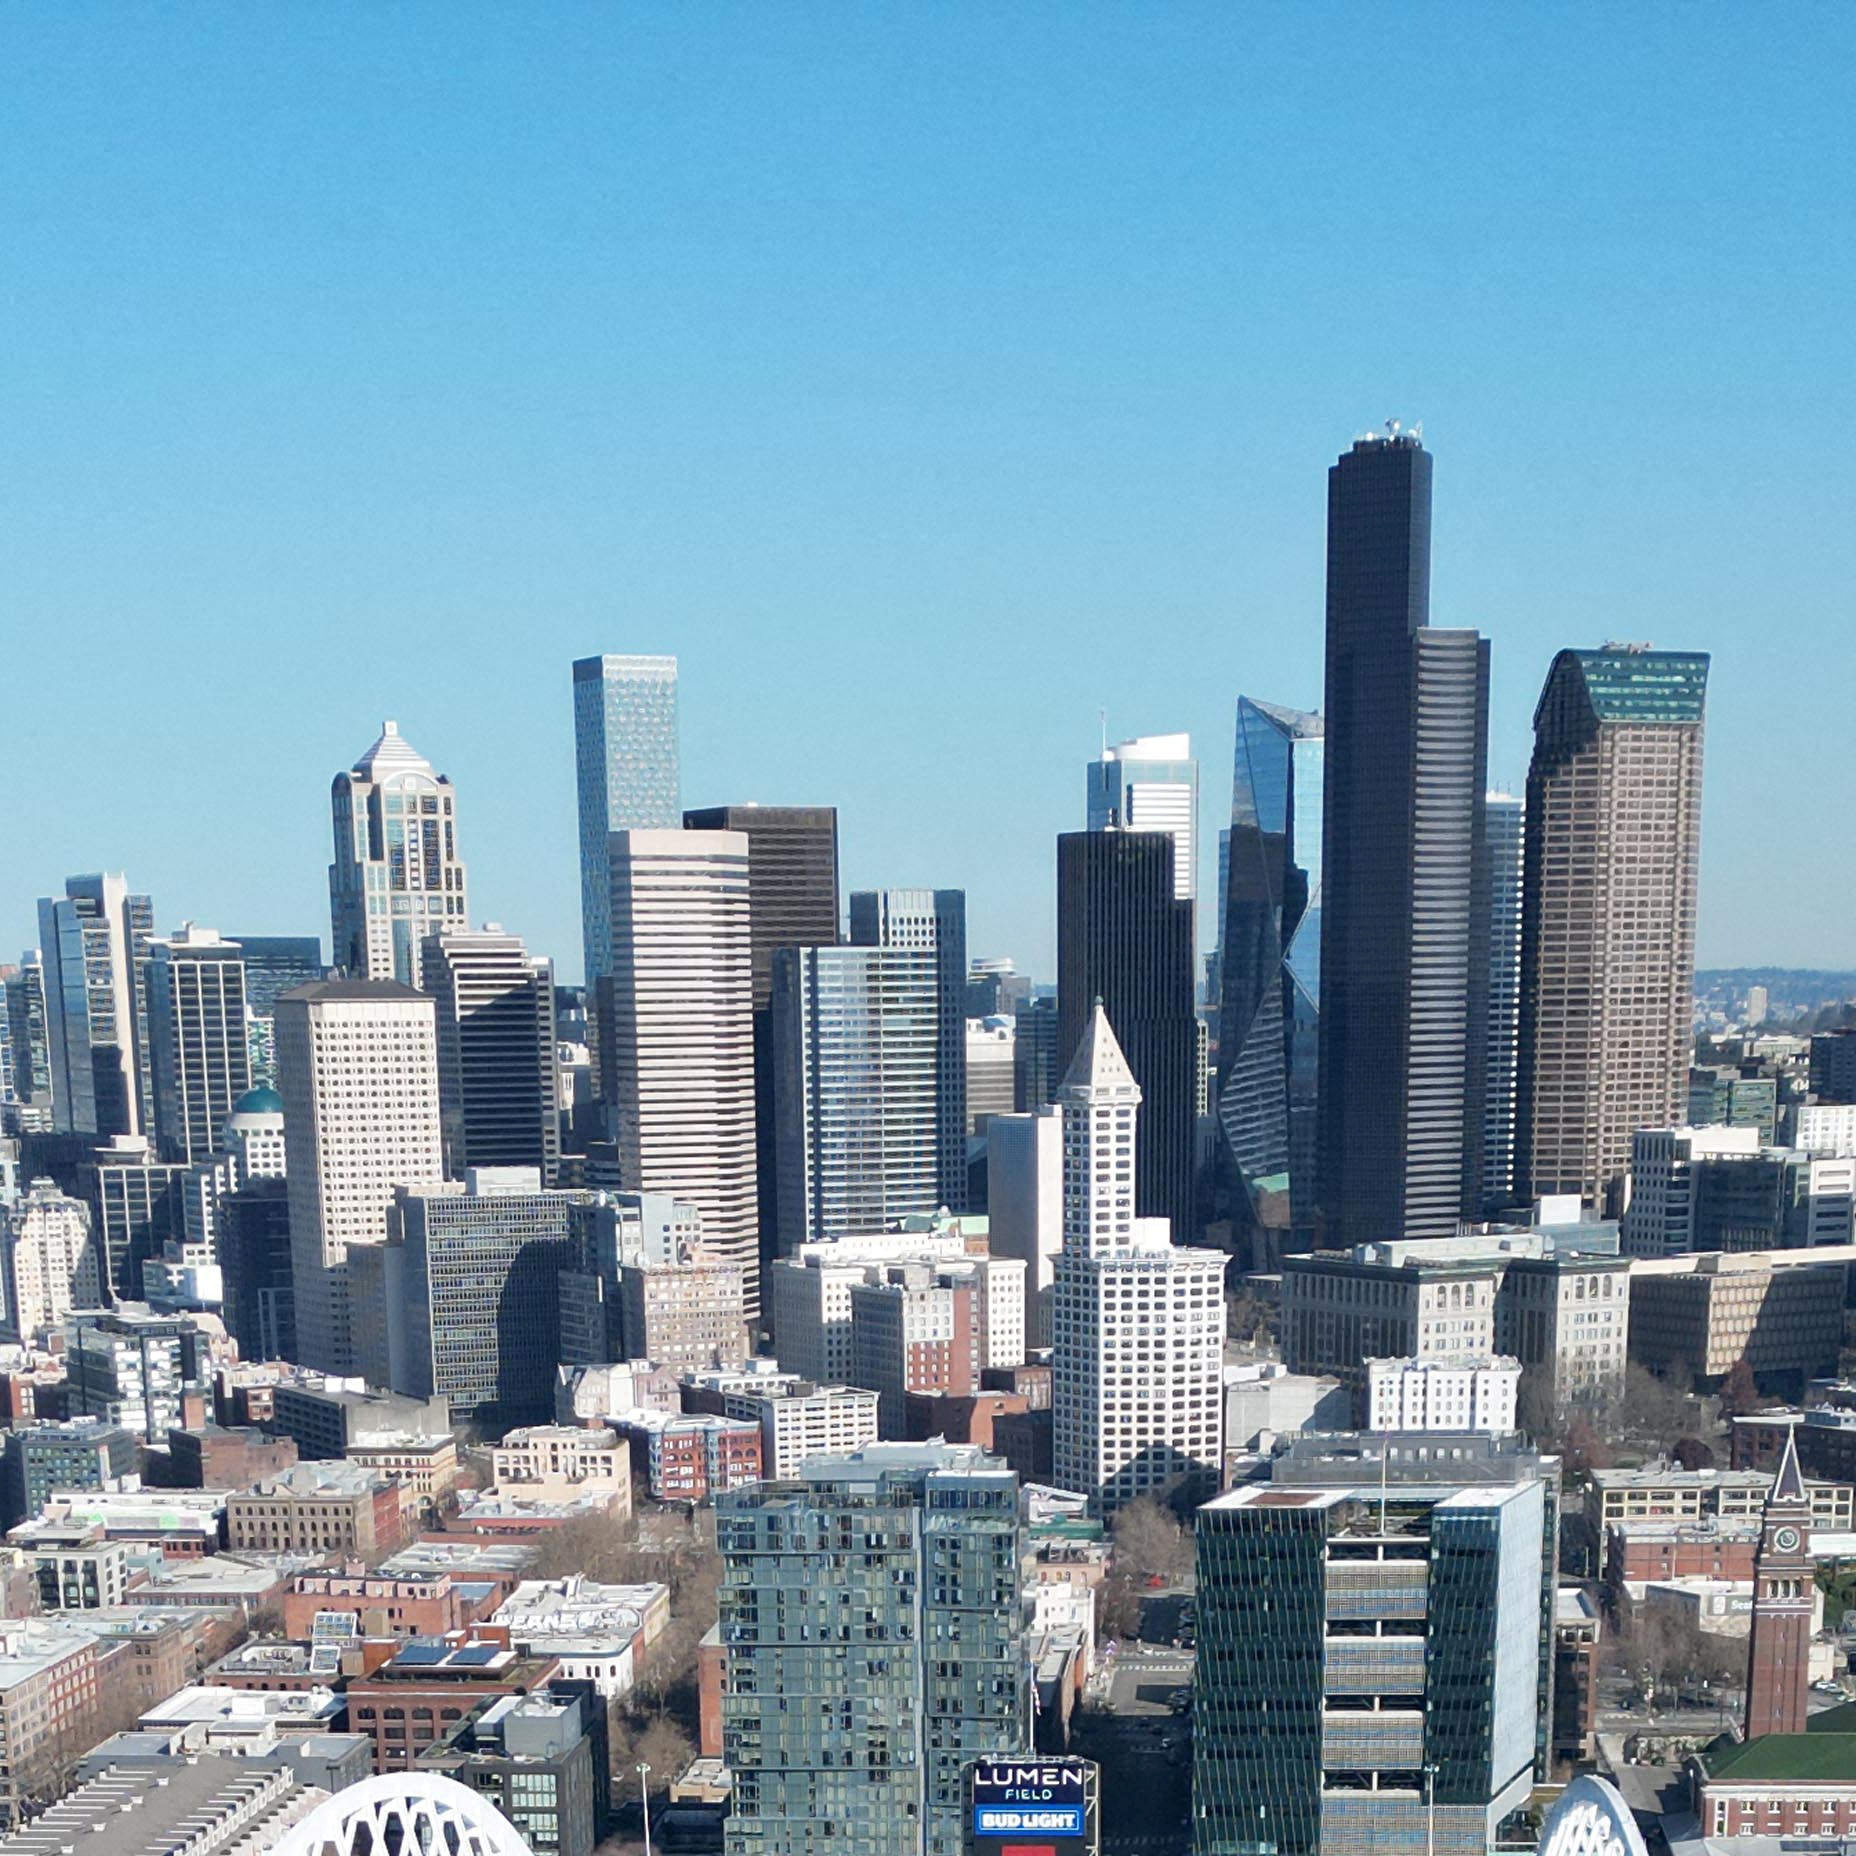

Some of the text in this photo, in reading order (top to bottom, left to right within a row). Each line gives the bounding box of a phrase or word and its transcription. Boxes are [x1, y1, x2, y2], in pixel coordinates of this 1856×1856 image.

[974, 1768, 1083, 1786] LUMEN
[1005, 1788, 1053, 1800] FIELD
[981, 1813, 1076, 1828] BUD LIGHT
